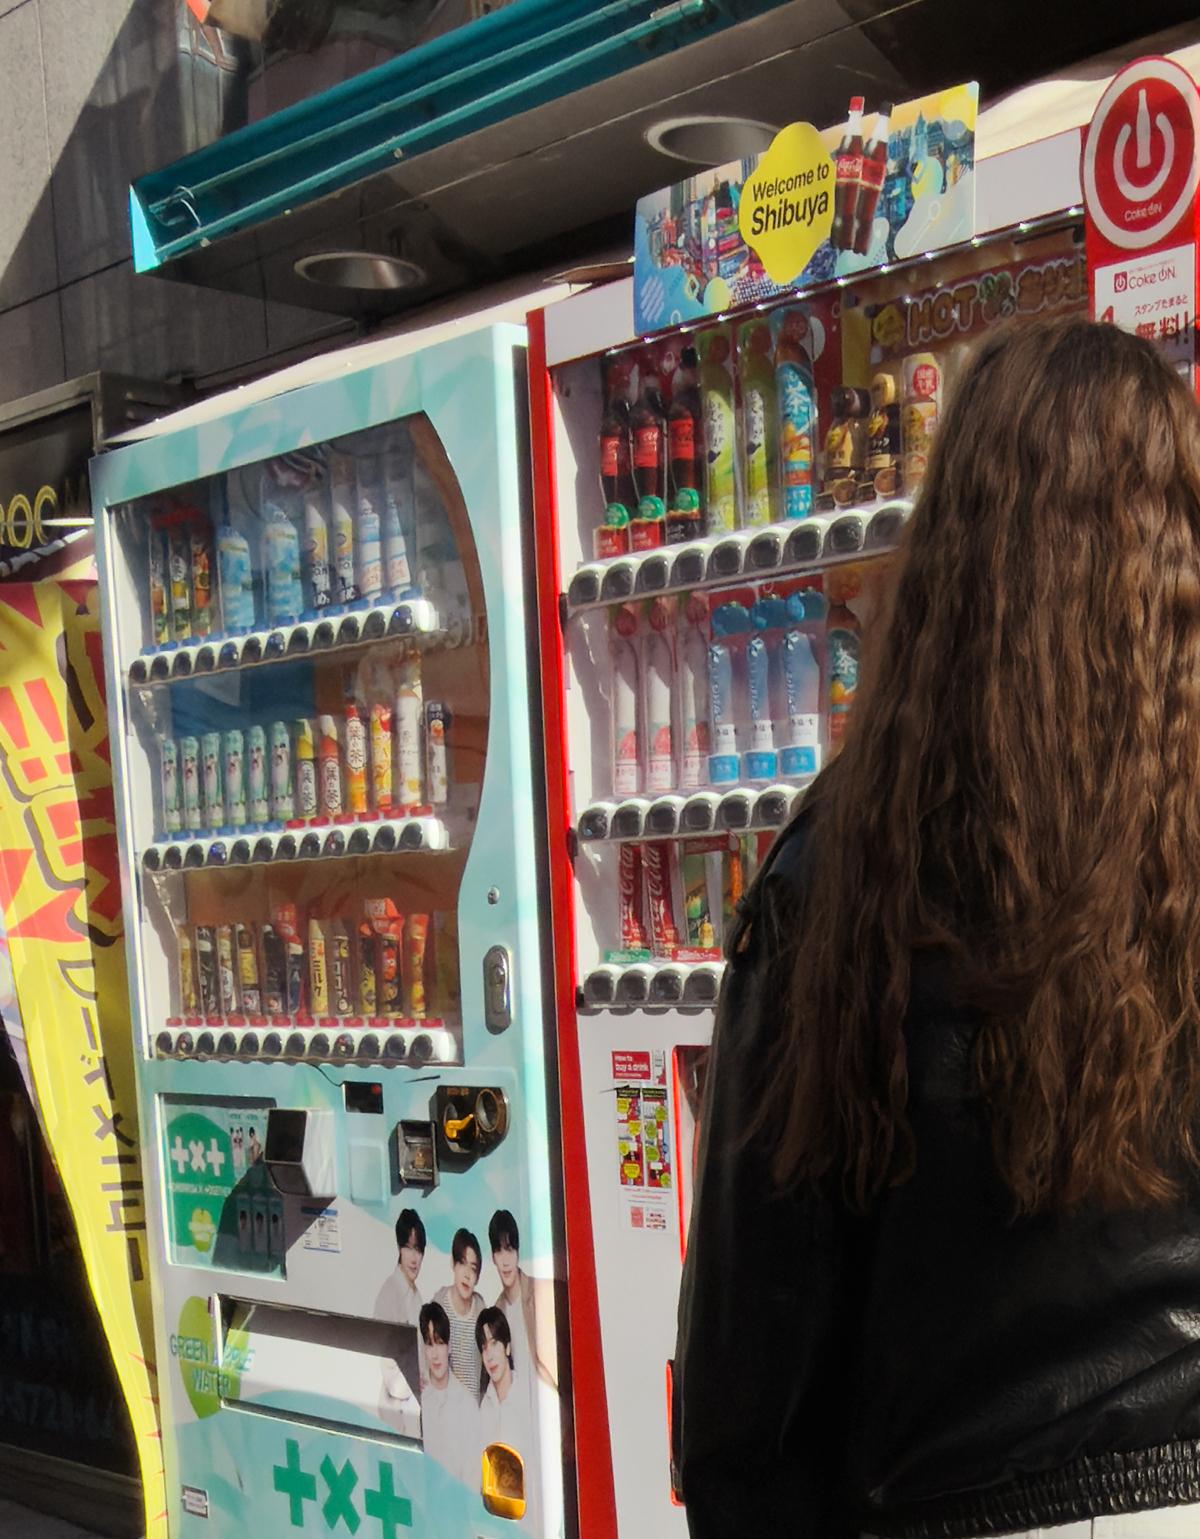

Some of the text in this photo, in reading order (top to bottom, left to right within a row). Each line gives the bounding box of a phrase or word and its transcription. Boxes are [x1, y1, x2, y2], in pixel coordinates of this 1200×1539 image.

[753, 163, 829, 201] Welcome to
[751, 191, 829, 236] Shibuya
[1129, 272, 1156, 289] Coke
[0, 485, 57, 548] OC
